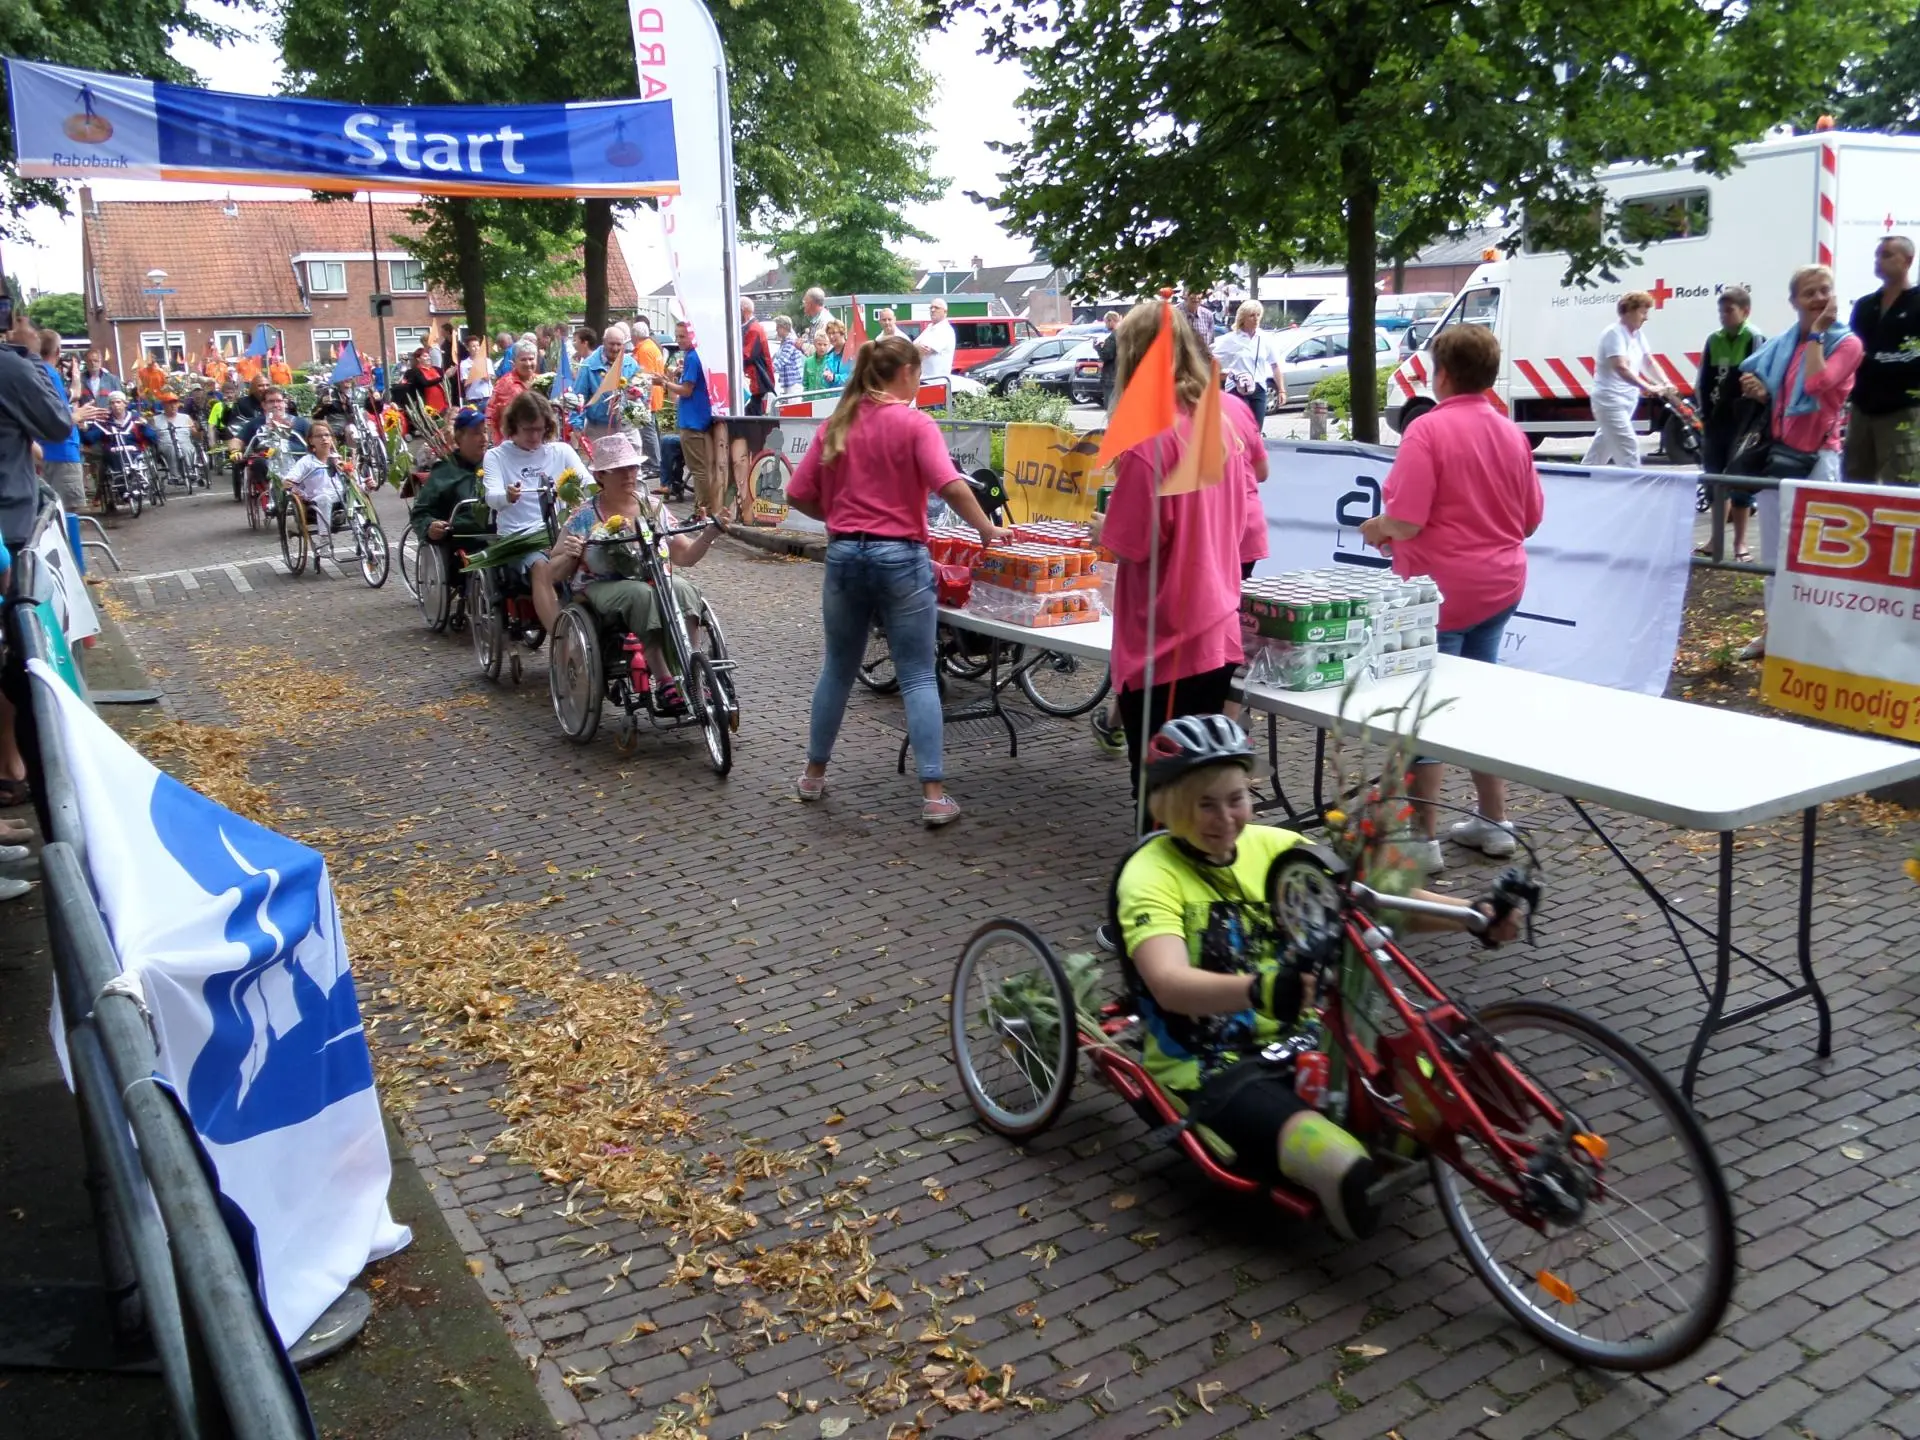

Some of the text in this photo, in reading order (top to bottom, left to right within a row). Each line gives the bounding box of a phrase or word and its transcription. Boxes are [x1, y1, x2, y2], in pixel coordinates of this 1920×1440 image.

[344, 113, 525, 174] Start
[52, 152, 129, 170] Rabobank
[1551, 297, 1568, 308] Het
[1675, 286, 1709, 299] Rode
[1792, 585, 1904, 618] THUISZORG
[1780, 667, 1828, 711] Zorg
